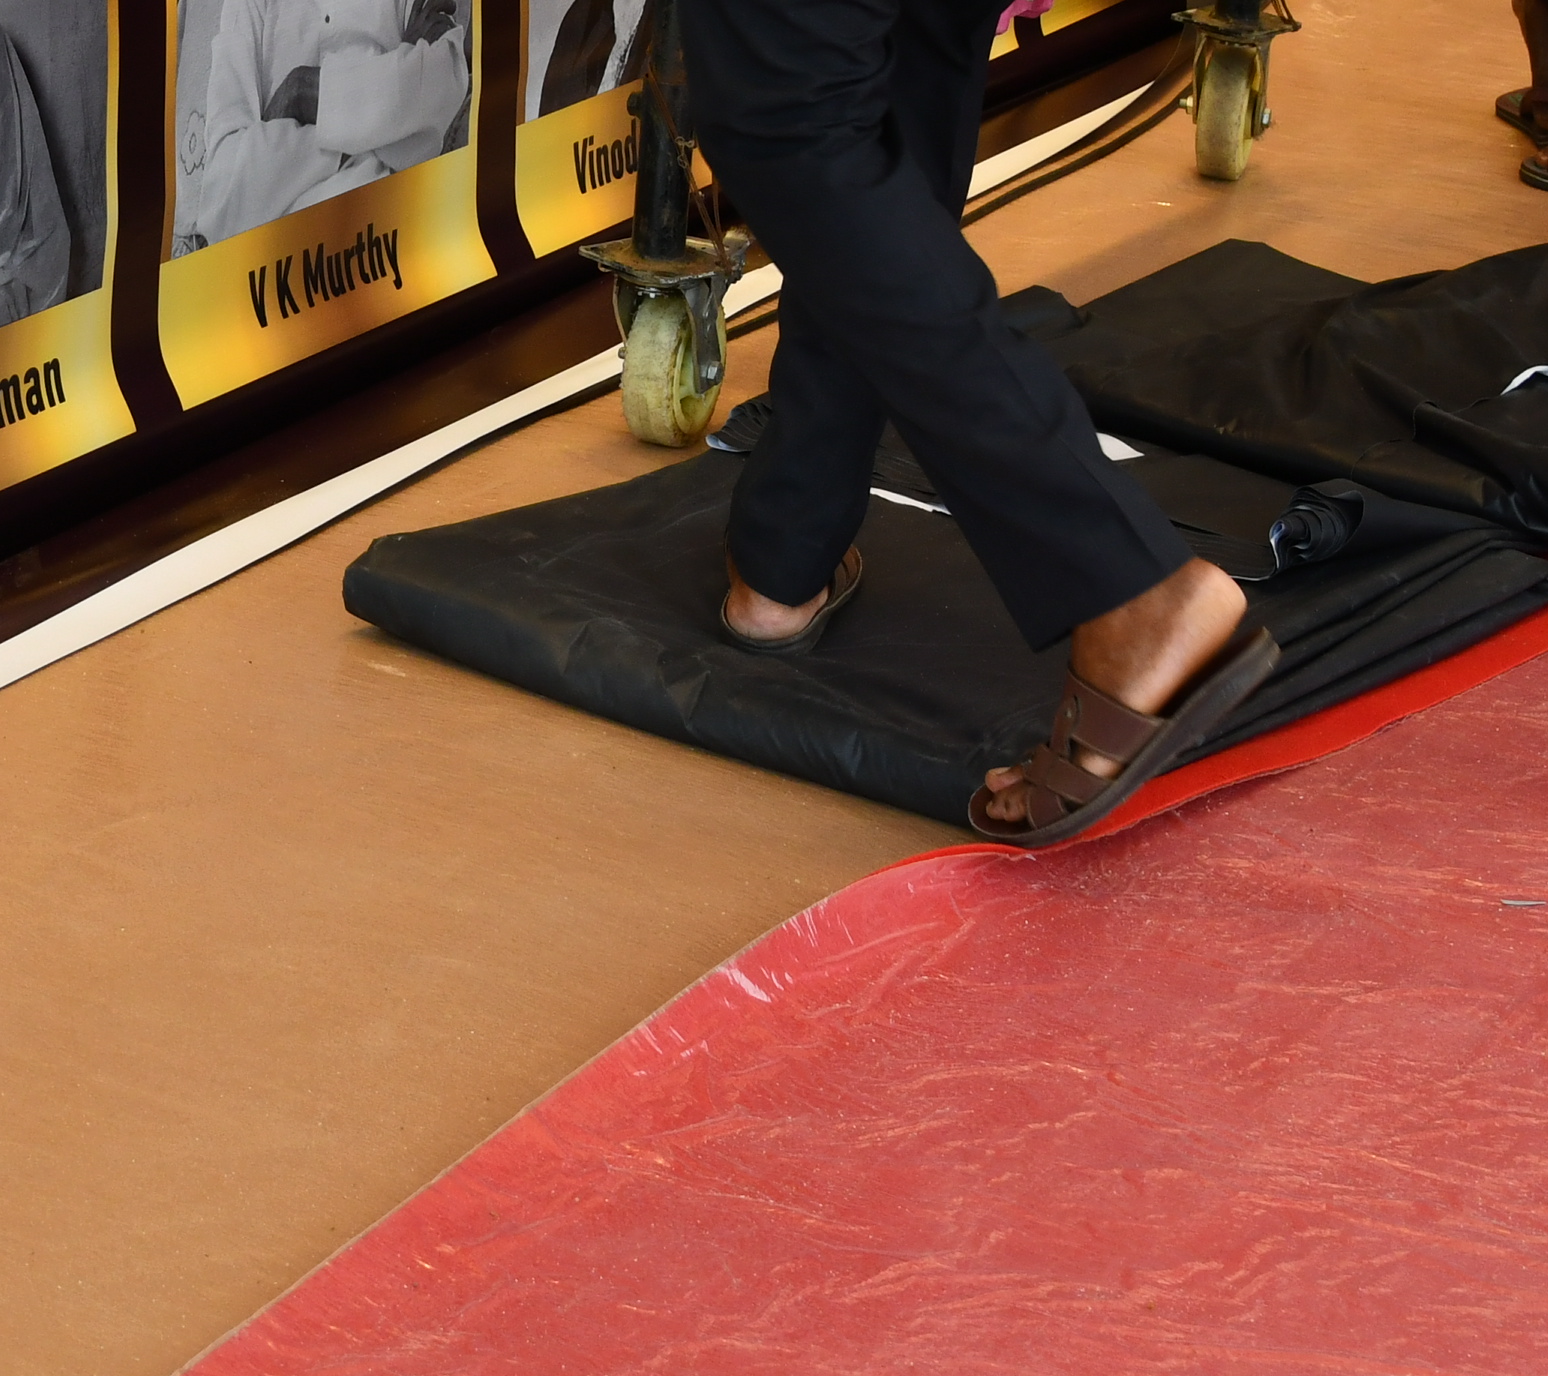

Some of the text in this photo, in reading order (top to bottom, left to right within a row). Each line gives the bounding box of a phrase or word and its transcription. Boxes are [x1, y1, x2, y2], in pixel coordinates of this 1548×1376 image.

[573, 118, 638, 195] Vinod
[249, 223, 402, 328] V K Murthy
